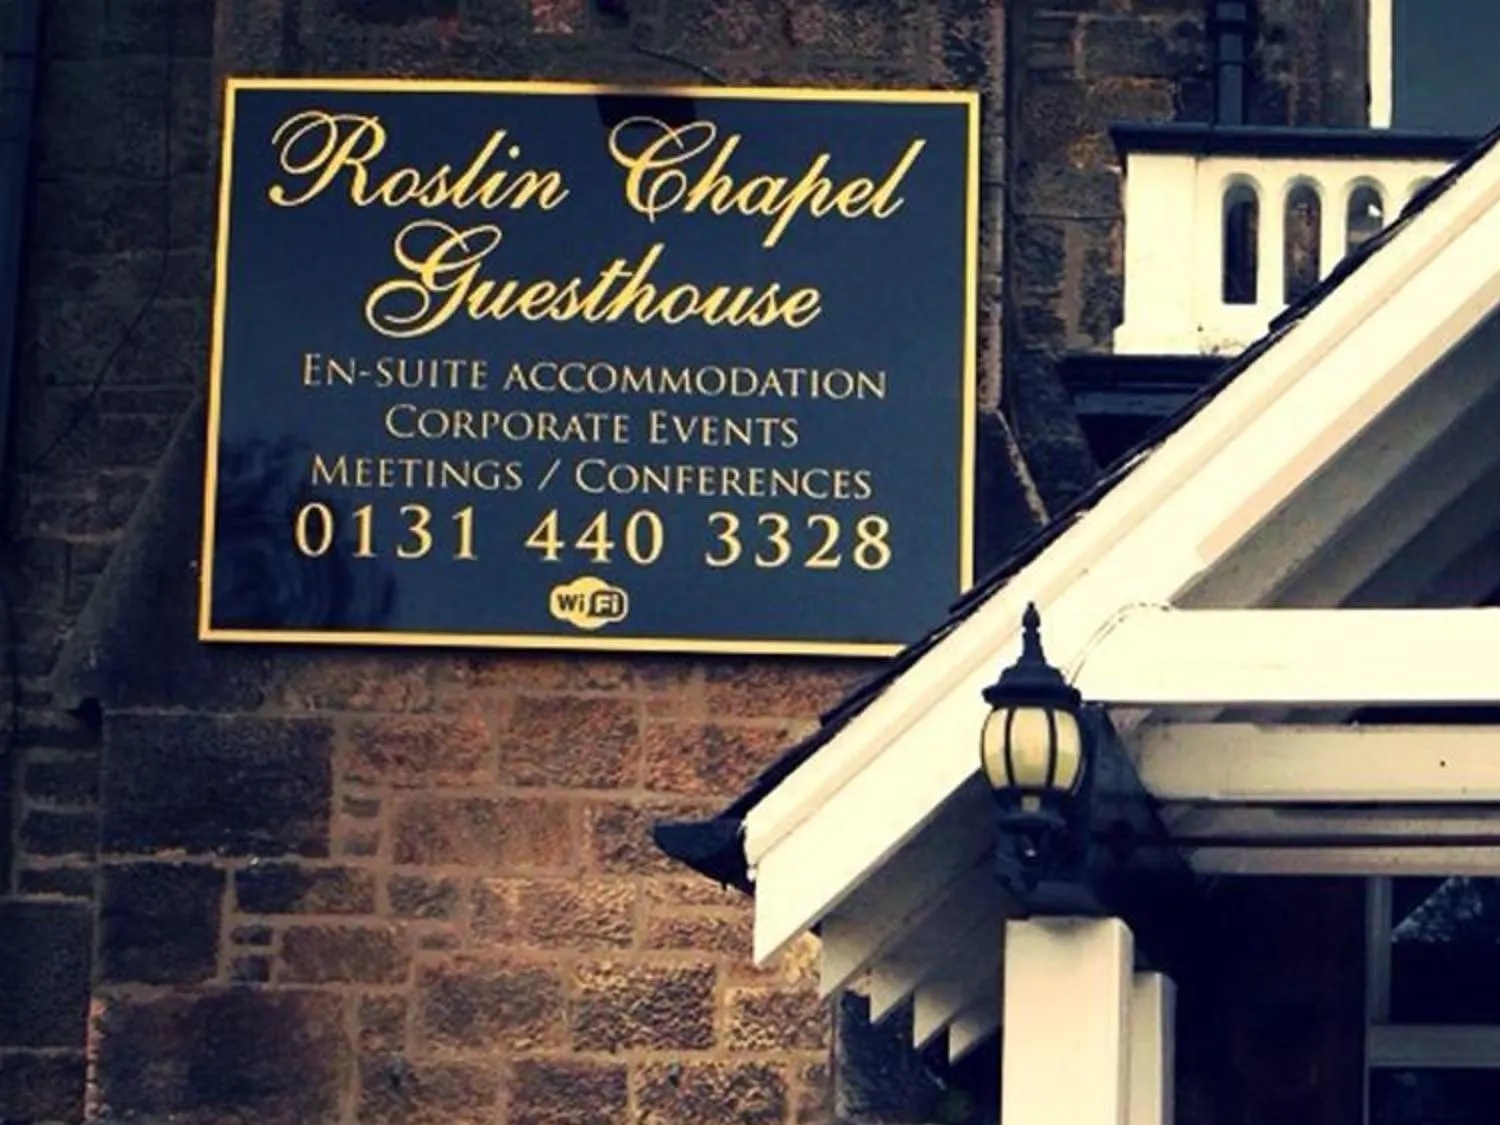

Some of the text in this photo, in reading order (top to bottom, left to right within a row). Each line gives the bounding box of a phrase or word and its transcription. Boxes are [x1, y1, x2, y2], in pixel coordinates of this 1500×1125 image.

[270, 110, 926, 248] Roslin Chapel
[364, 219, 822, 338] Guesthouse
[302, 353, 887, 400] EN-SUITE ACCOMMODATION
[384, 404, 799, 448] CORPORATE EVENTS
[310, 454, 523, 491] MEETINGS
[574, 458, 873, 500] CONFERENCES
[294, 503, 893, 571] 0131 440 3328
